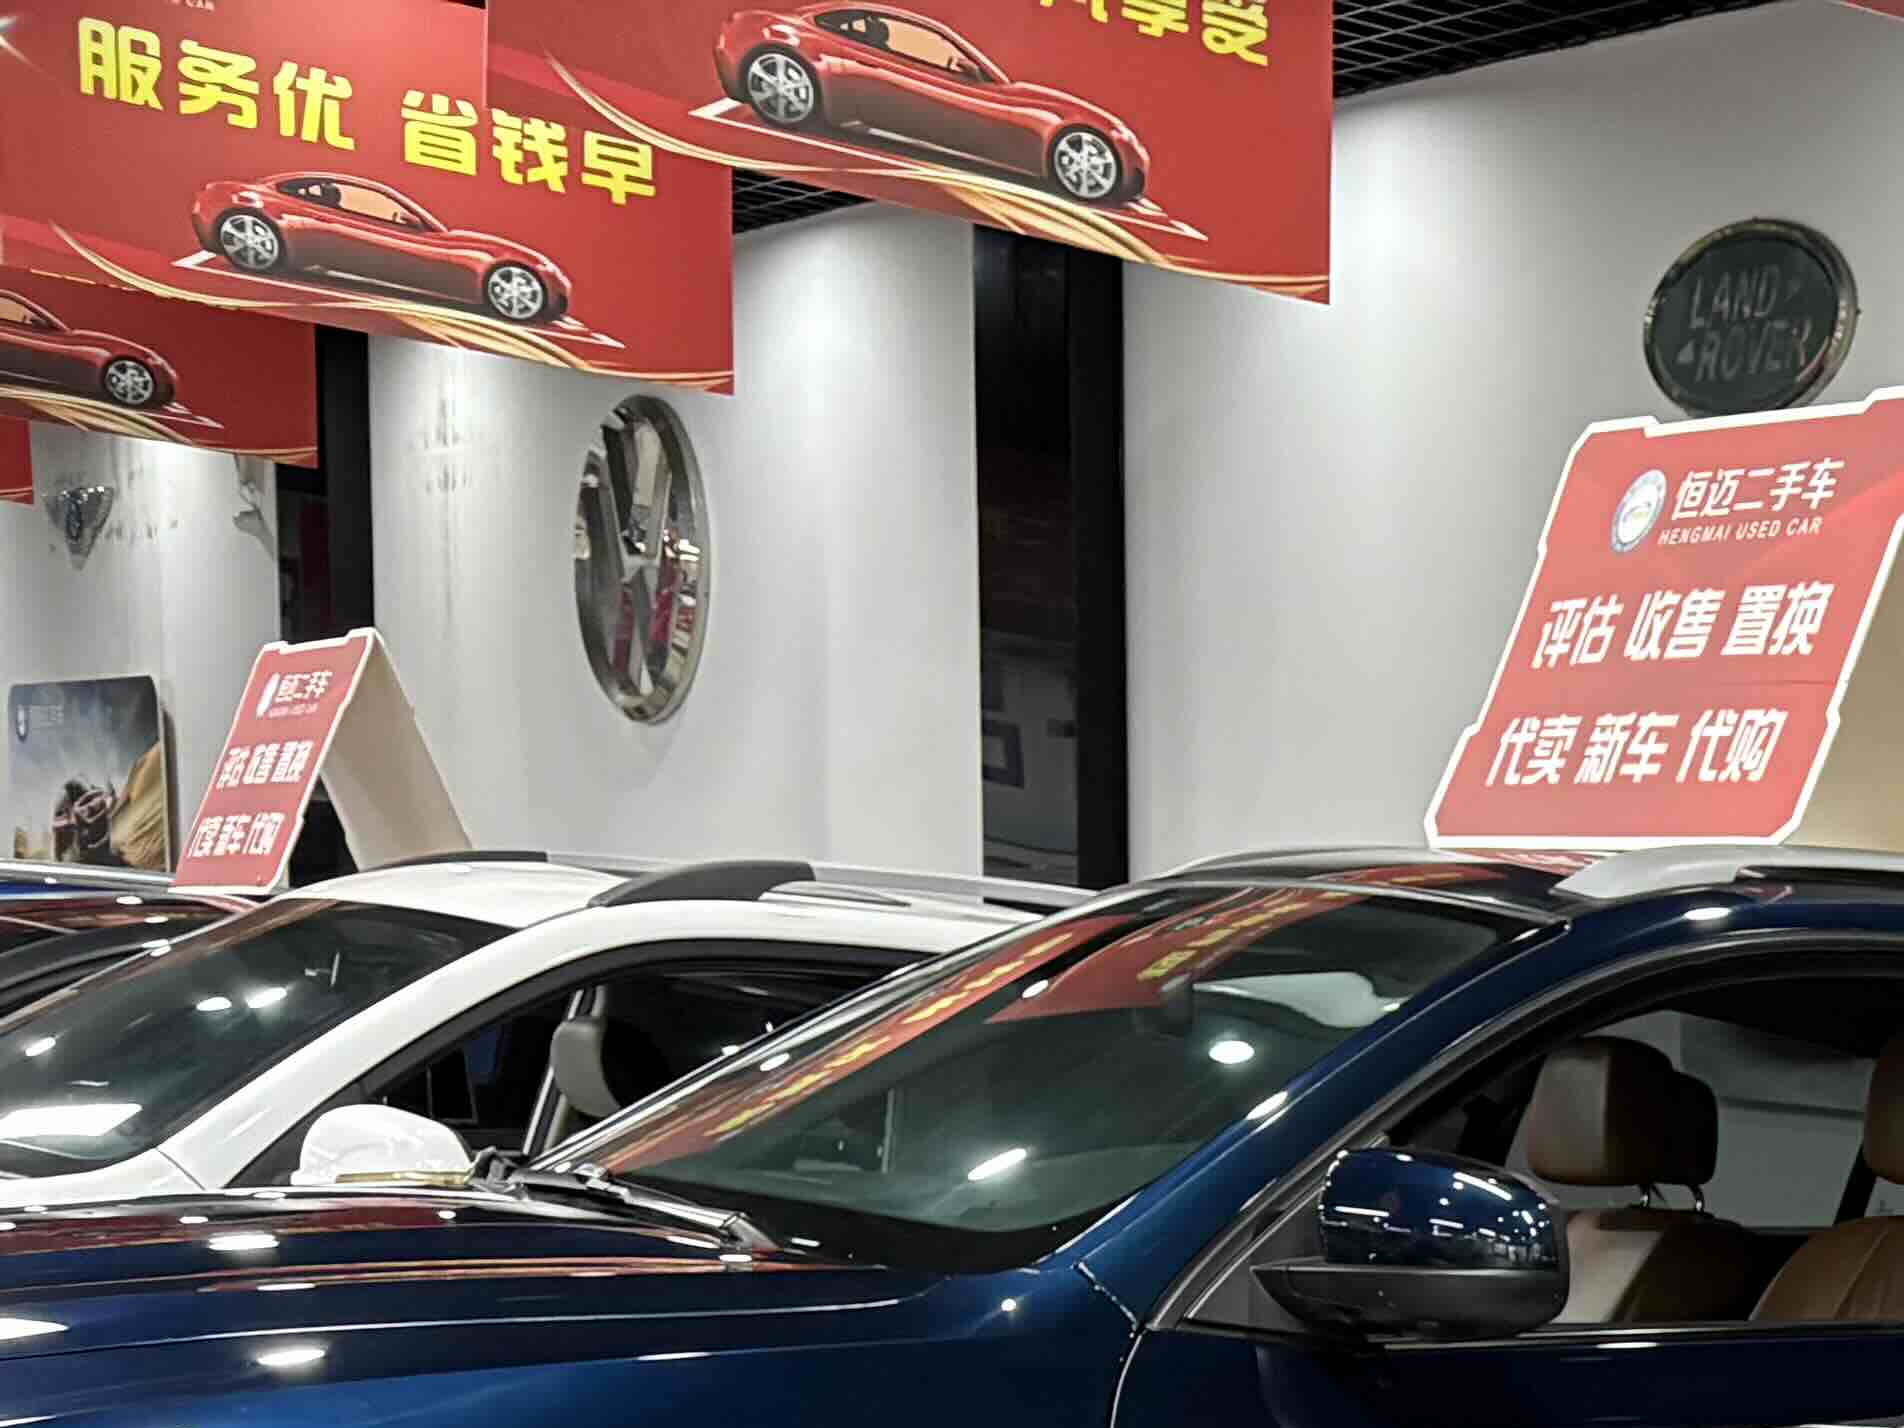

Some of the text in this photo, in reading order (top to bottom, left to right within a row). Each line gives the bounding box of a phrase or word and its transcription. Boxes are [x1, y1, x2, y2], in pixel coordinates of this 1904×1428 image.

[78, 17, 656, 205] 服务优 省钱早
[1690, 264, 1780, 329] LAND
[1695, 318, 1813, 382] ROVER
[1671, 457, 1845, 521] 恒迈二手车
[1658, 517, 1823, 547] HENGMAI USED CAR
[1531, 581, 1835, 669] 评估 收售 置换
[1485, 708, 1789, 787] 代卖 新车 代购
